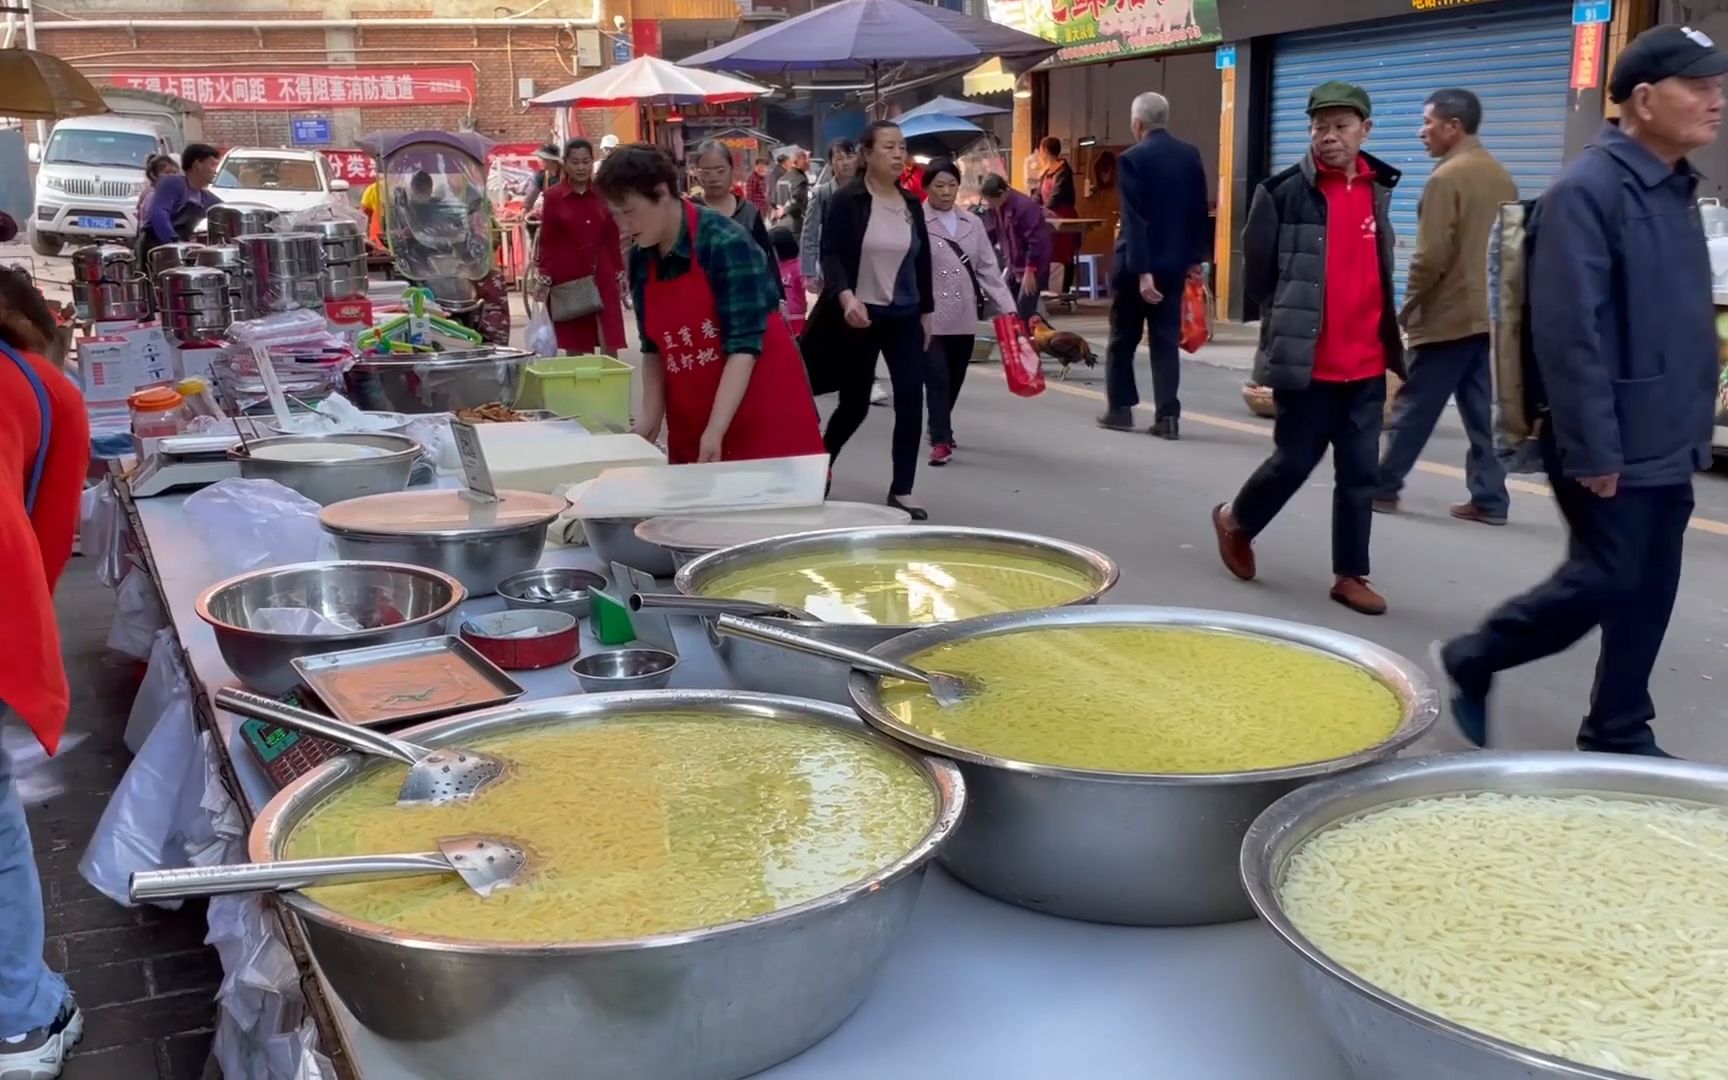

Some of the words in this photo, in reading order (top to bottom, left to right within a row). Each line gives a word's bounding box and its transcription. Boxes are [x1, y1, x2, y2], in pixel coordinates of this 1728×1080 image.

[1585, 8, 1597, 21] 91
[278, 75, 414, 103] 不得阻塞消防通道
